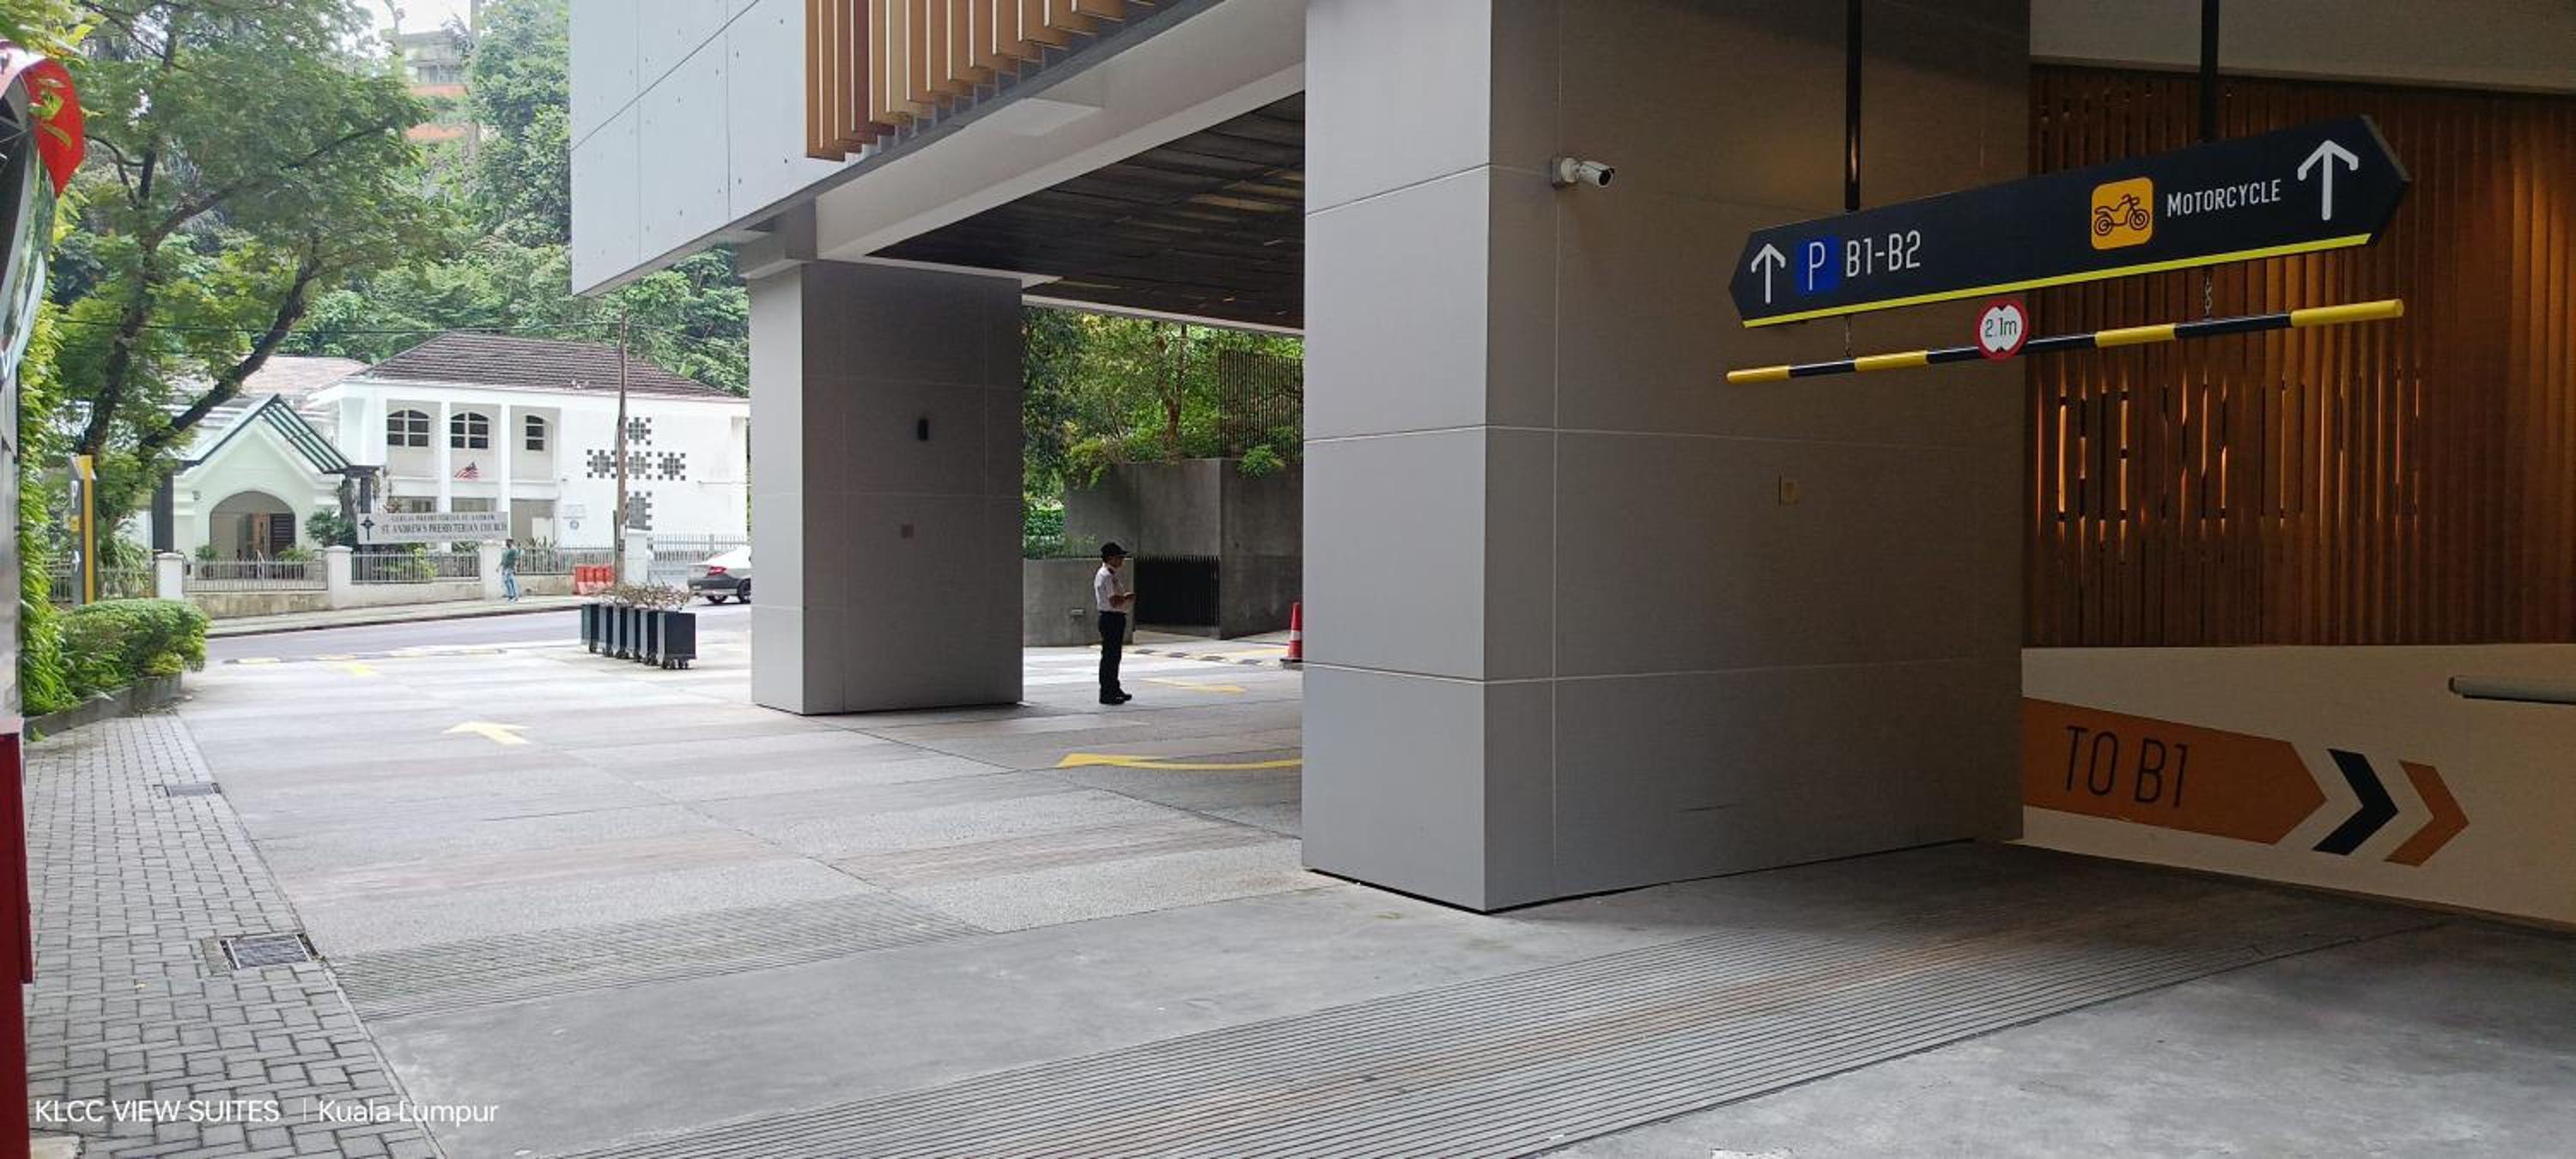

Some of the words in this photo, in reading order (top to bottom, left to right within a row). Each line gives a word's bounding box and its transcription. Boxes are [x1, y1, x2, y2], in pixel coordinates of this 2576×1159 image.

[2166, 179, 2281, 217] MOTORCYCLE
[1808, 241, 1826, 291] P
[1847, 230, 1921, 277] B1-B2
[2066, 725, 2118, 796] TO
[2135, 737, 2189, 809] B1
